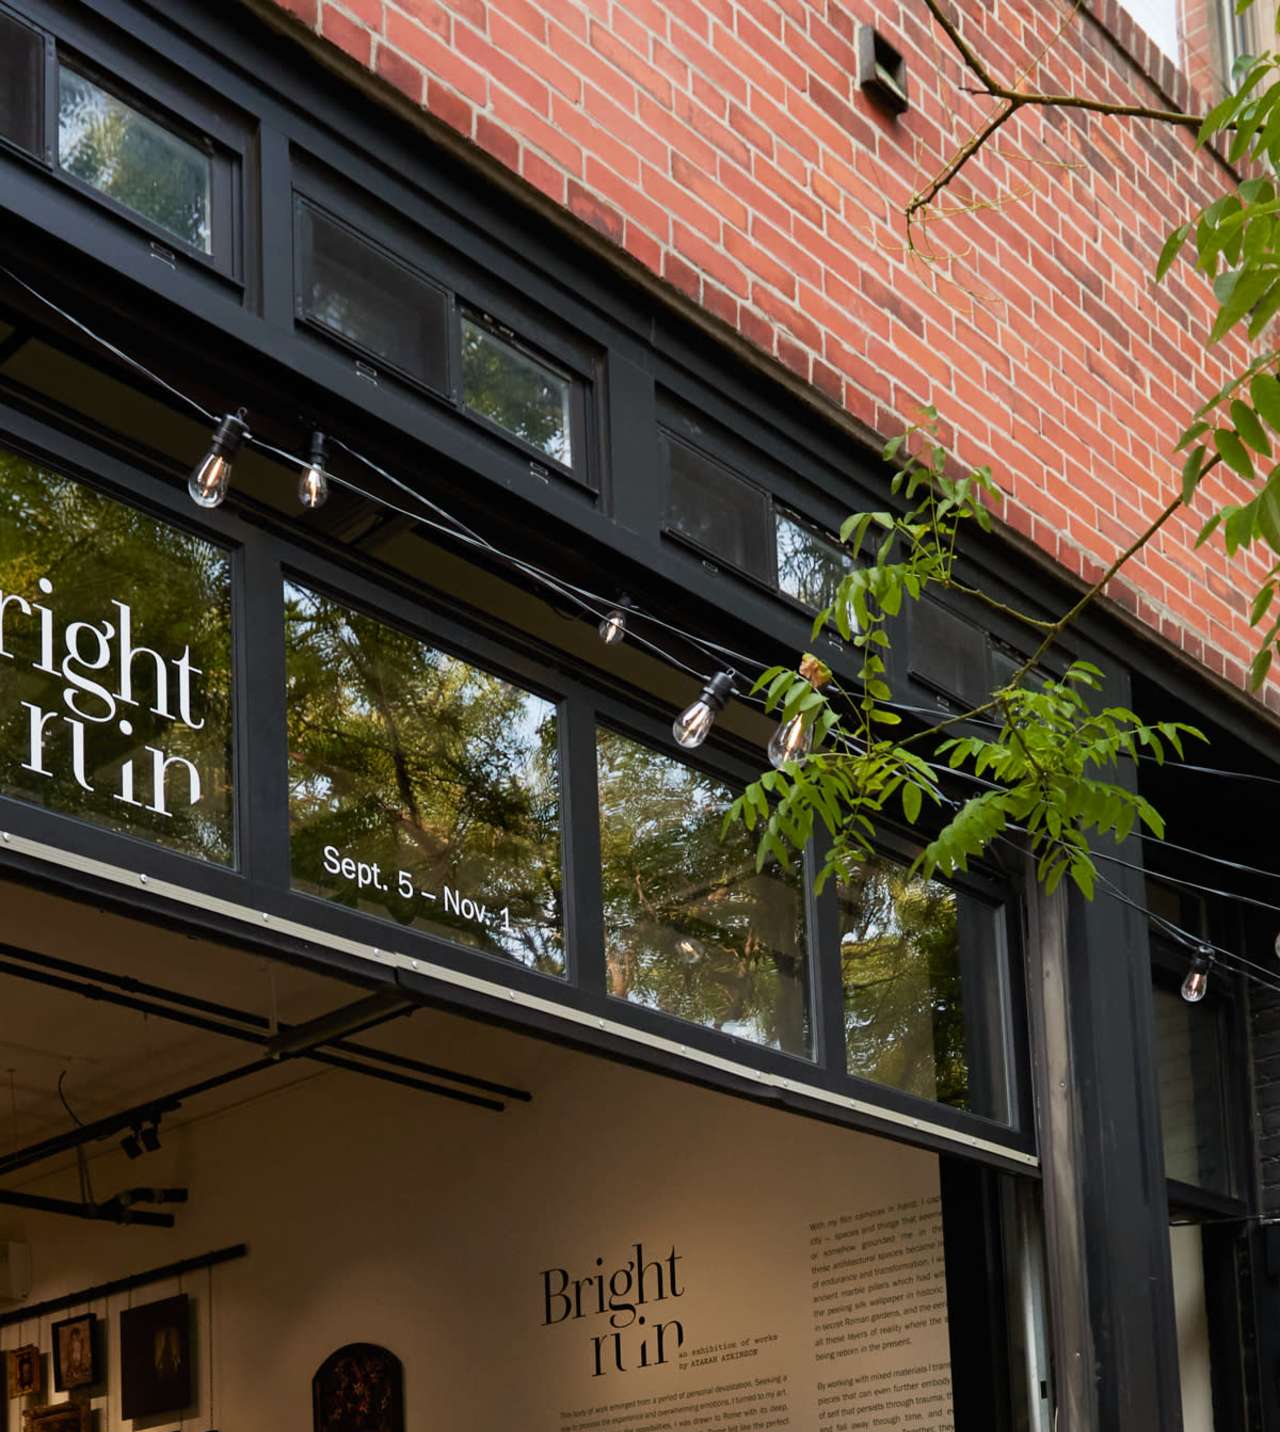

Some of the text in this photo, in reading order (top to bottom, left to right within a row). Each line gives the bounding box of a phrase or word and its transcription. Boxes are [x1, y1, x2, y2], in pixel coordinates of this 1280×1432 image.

[324, 846, 388, 892] Sept.
[398, 870, 413, 897] 5
[445, 887, 494, 925] Nov.
[501, 906, 512, 931] 1
[540, 1243, 684, 1331] Bright
